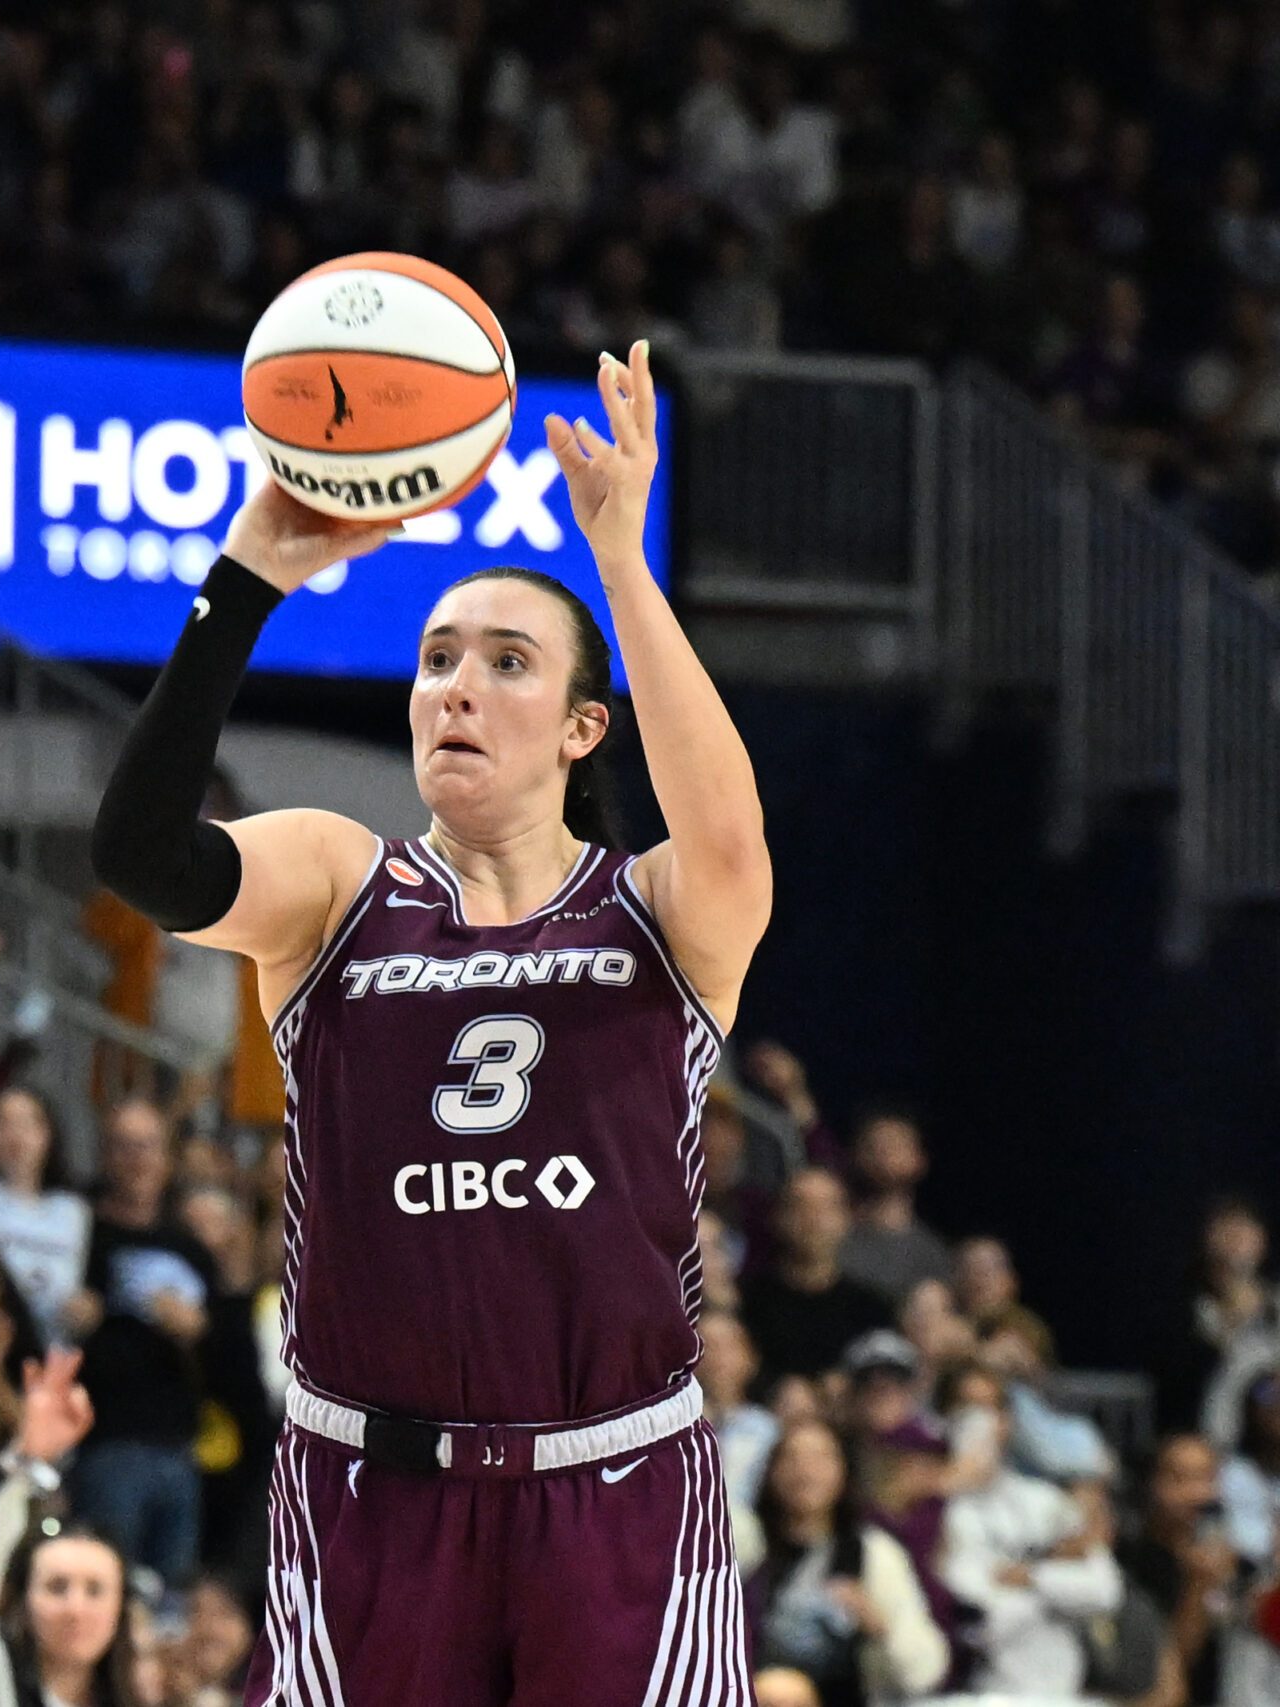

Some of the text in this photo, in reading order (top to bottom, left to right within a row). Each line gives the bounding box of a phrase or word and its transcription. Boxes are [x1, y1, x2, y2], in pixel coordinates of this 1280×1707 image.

[269, 452, 443, 509] Wilson
[544, 894, 619, 927] EPHORA
[343, 948, 636, 999] TORONTO
[431, 1014, 546, 1134] 3
[394, 1159, 529, 1215] CIBC
